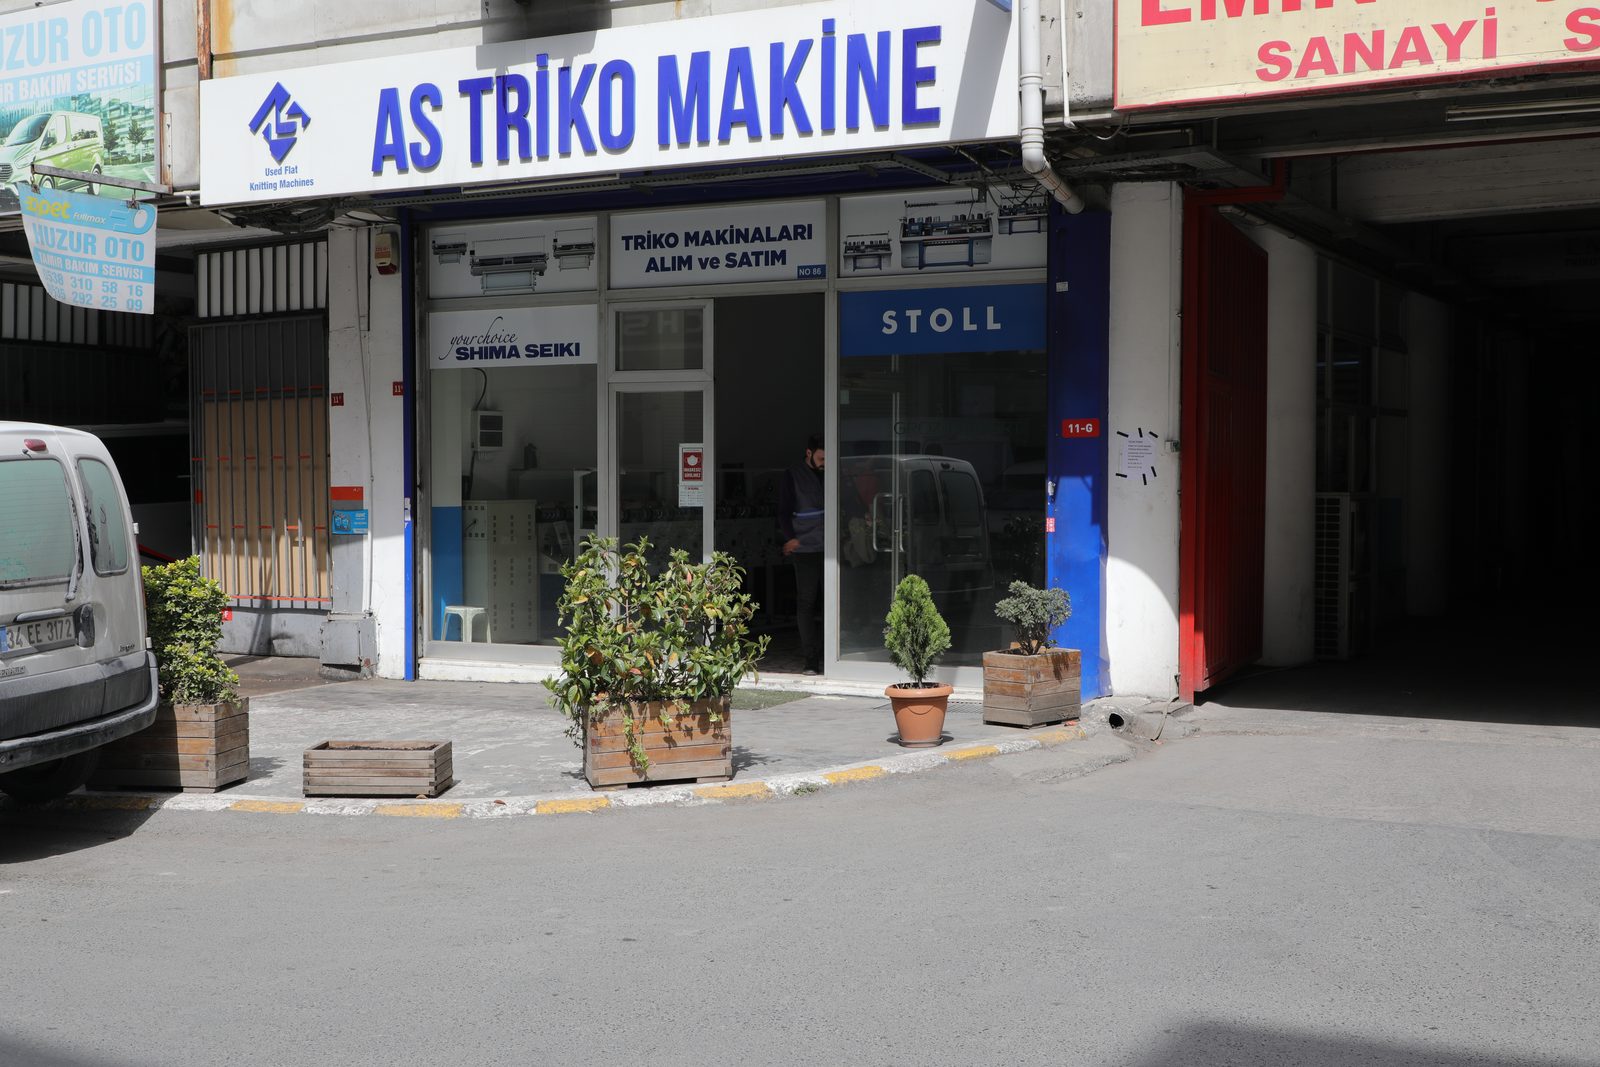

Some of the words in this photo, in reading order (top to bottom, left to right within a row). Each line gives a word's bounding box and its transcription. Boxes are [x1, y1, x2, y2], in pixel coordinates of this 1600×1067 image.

[0, 17, 69, 71] ZUR
[82, 2, 146, 57] OTO
[1256, 7, 1498, 82] SANAYİ
[20, 72, 71, 100] BAKIM
[371, 82, 443, 174] AS
[458, 53, 635, 165] TRİKO
[658, 18, 942, 148] MAKİNE
[265, 166, 283, 176] Used
[284, 165, 298, 175] Flat
[249, 181, 278, 191] Knitting
[279, 178, 314, 189] Machines
[32, 223, 97, 256] HUZUR
[104, 236, 145, 262] OTO
[621, 230, 680, 251] TRİKO
[684, 223, 813, 248] MAKİNALARI
[65, 258, 99, 274] BAKIM
[645, 255, 692, 273] ALIM
[698, 256, 721, 270] ve
[725, 250, 787, 269] SATIM
[799, 268, 811, 276] NO
[812, 267, 822, 276] 86
[71, 276, 93, 291] 310
[102, 281, 118, 295] 58
[128, 284, 143, 298] 16
[72, 290, 93, 306] 292
[101, 295, 118, 309] 25
[127, 299, 143, 312] 09
[881, 306, 1001, 335] STOLL
[455, 344, 521, 361] SHIMA
[525, 342, 580, 359] SEIKI
[1068, 423, 1093, 434] 11-G
[7, 626, 24, 649] 34
[27, 624, 42, 645] EE
[47, 619, 72, 641] 3172
